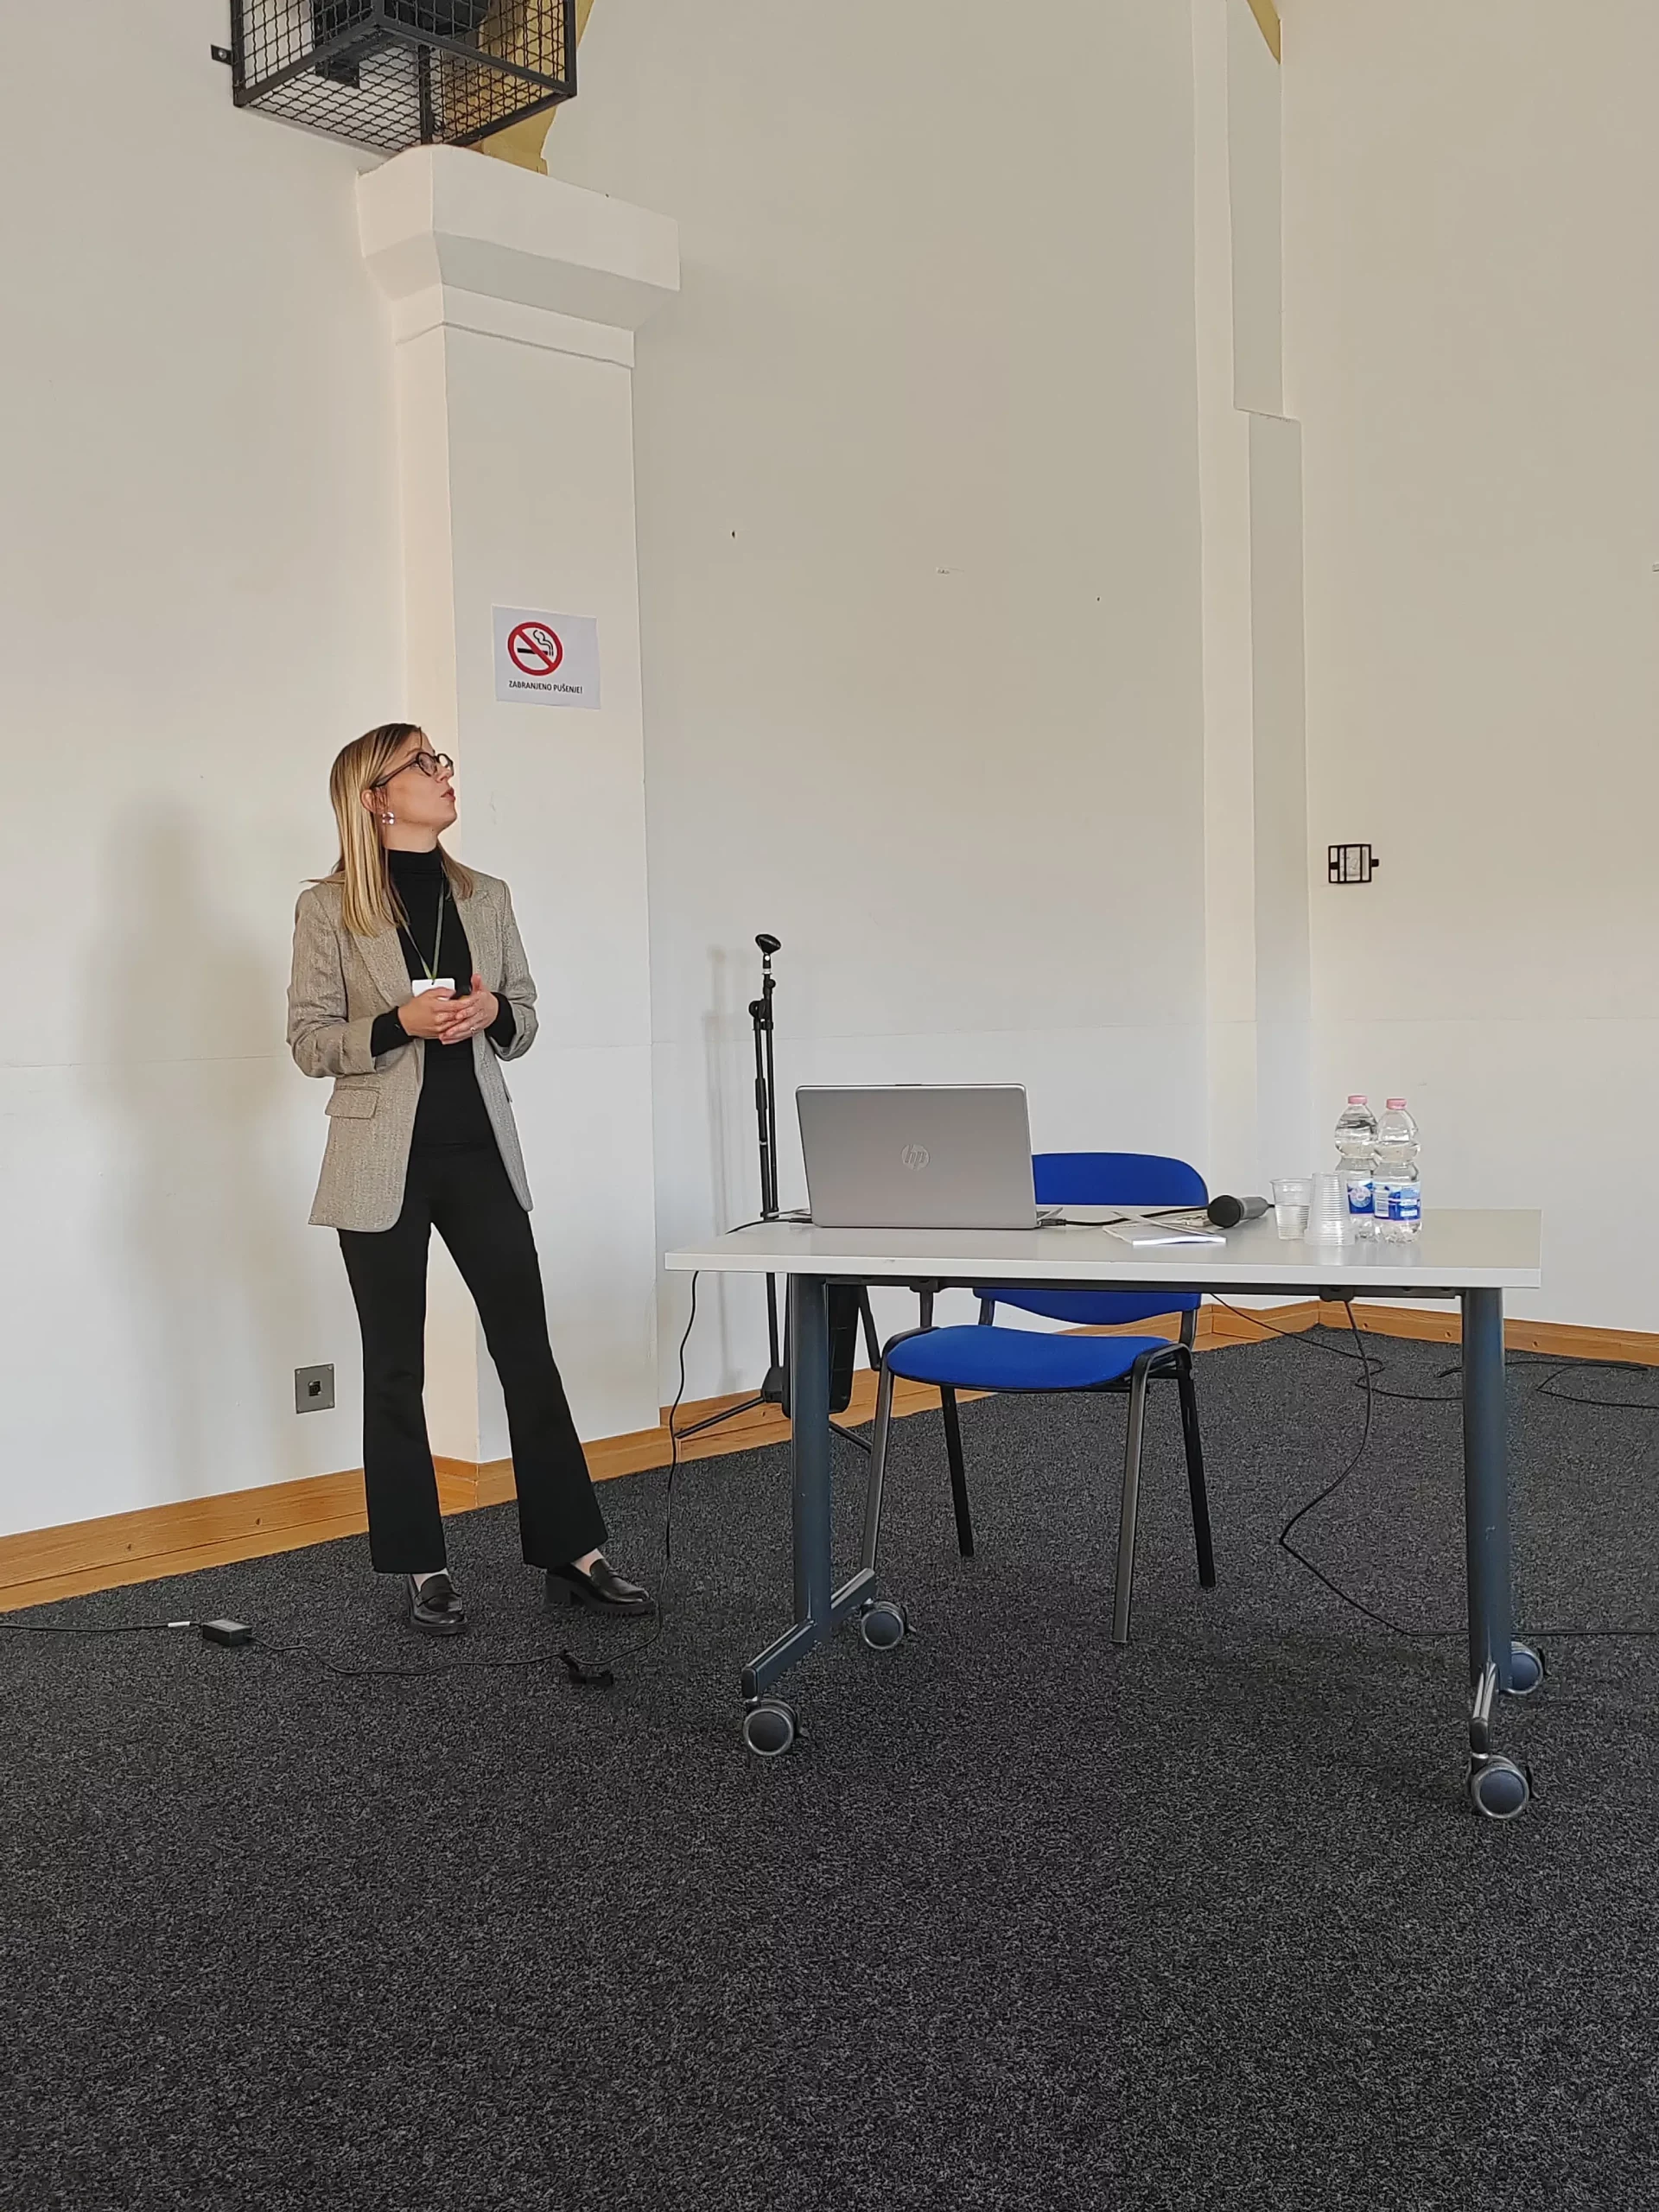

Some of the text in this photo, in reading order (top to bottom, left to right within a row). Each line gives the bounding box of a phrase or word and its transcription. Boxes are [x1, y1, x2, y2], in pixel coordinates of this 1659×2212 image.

[509, 680, 583, 694] ZABRANJENO PUŠENJE!
[904, 1144, 926, 1170] hp
